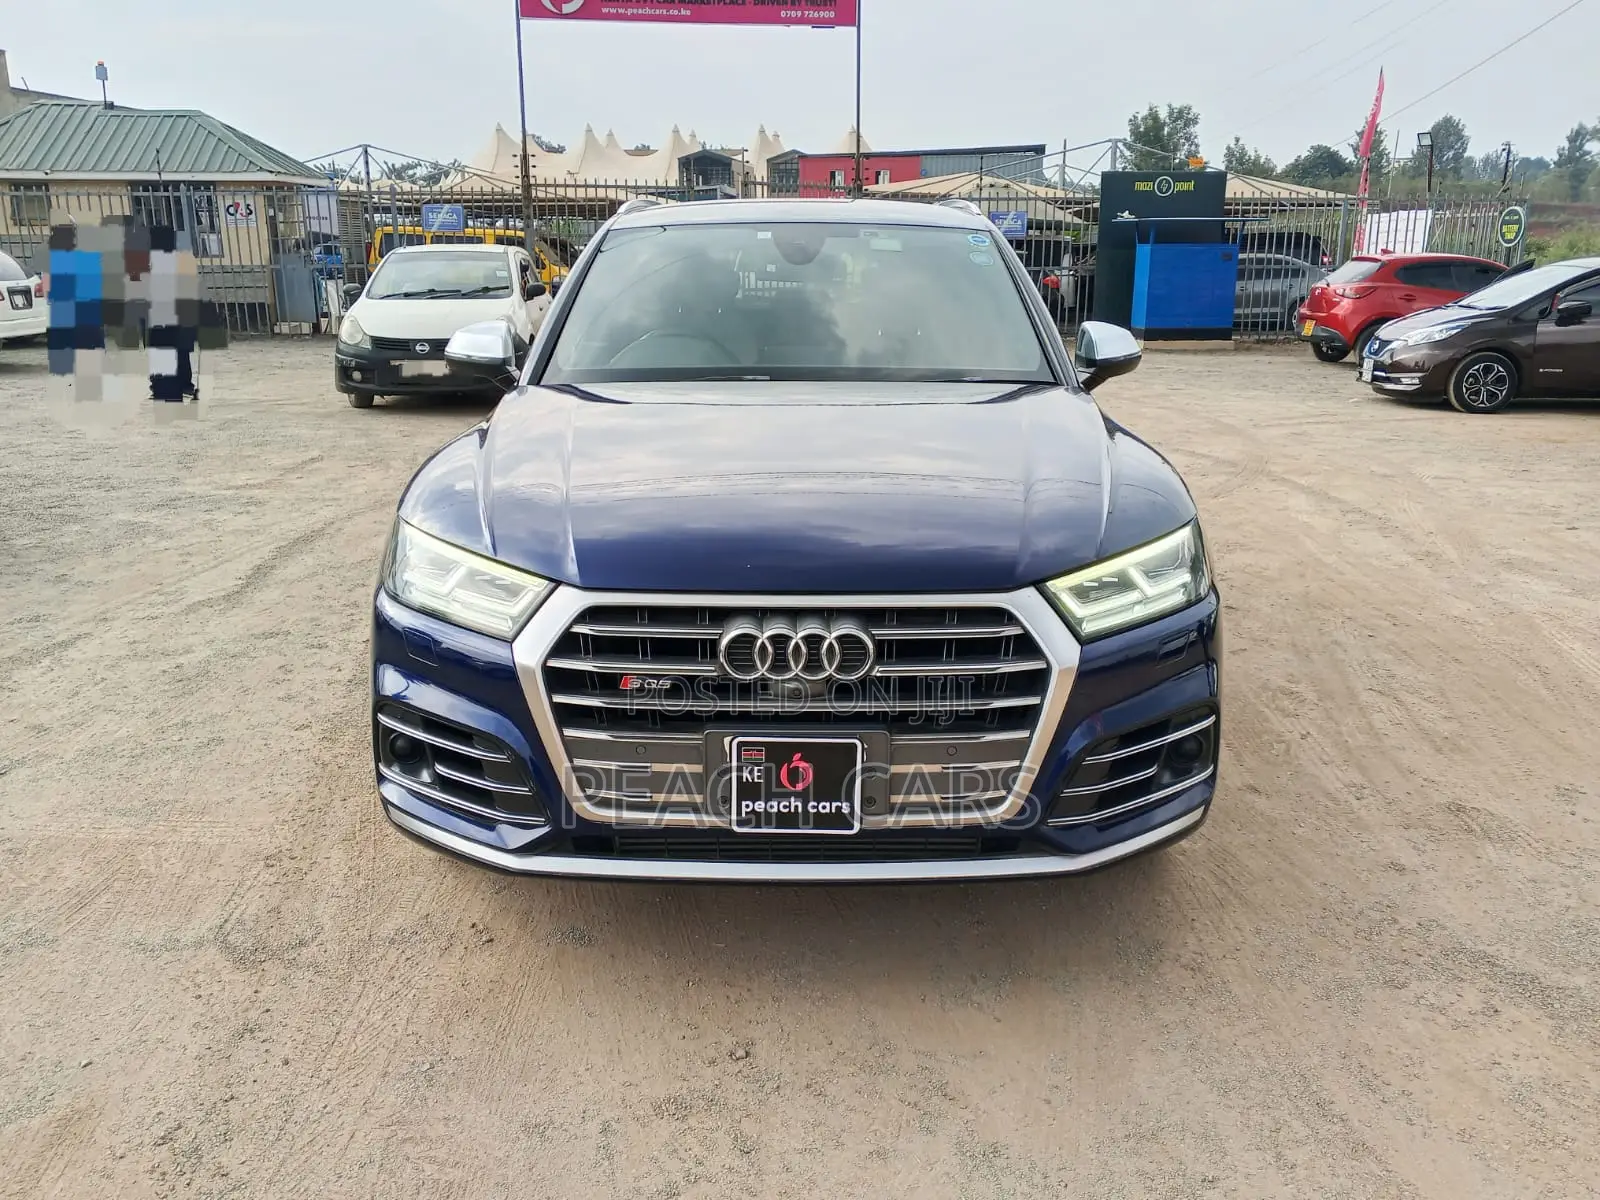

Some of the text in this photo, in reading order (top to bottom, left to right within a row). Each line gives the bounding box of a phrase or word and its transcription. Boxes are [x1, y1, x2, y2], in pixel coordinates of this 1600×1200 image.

[601, 7, 691, 16] www.peachcars.co.ke
[781, 10, 835, 18] 0709 726900
[1173, 180, 1194, 194] point
[742, 766, 764, 782] KE
[741, 796, 851, 817] peach cars
